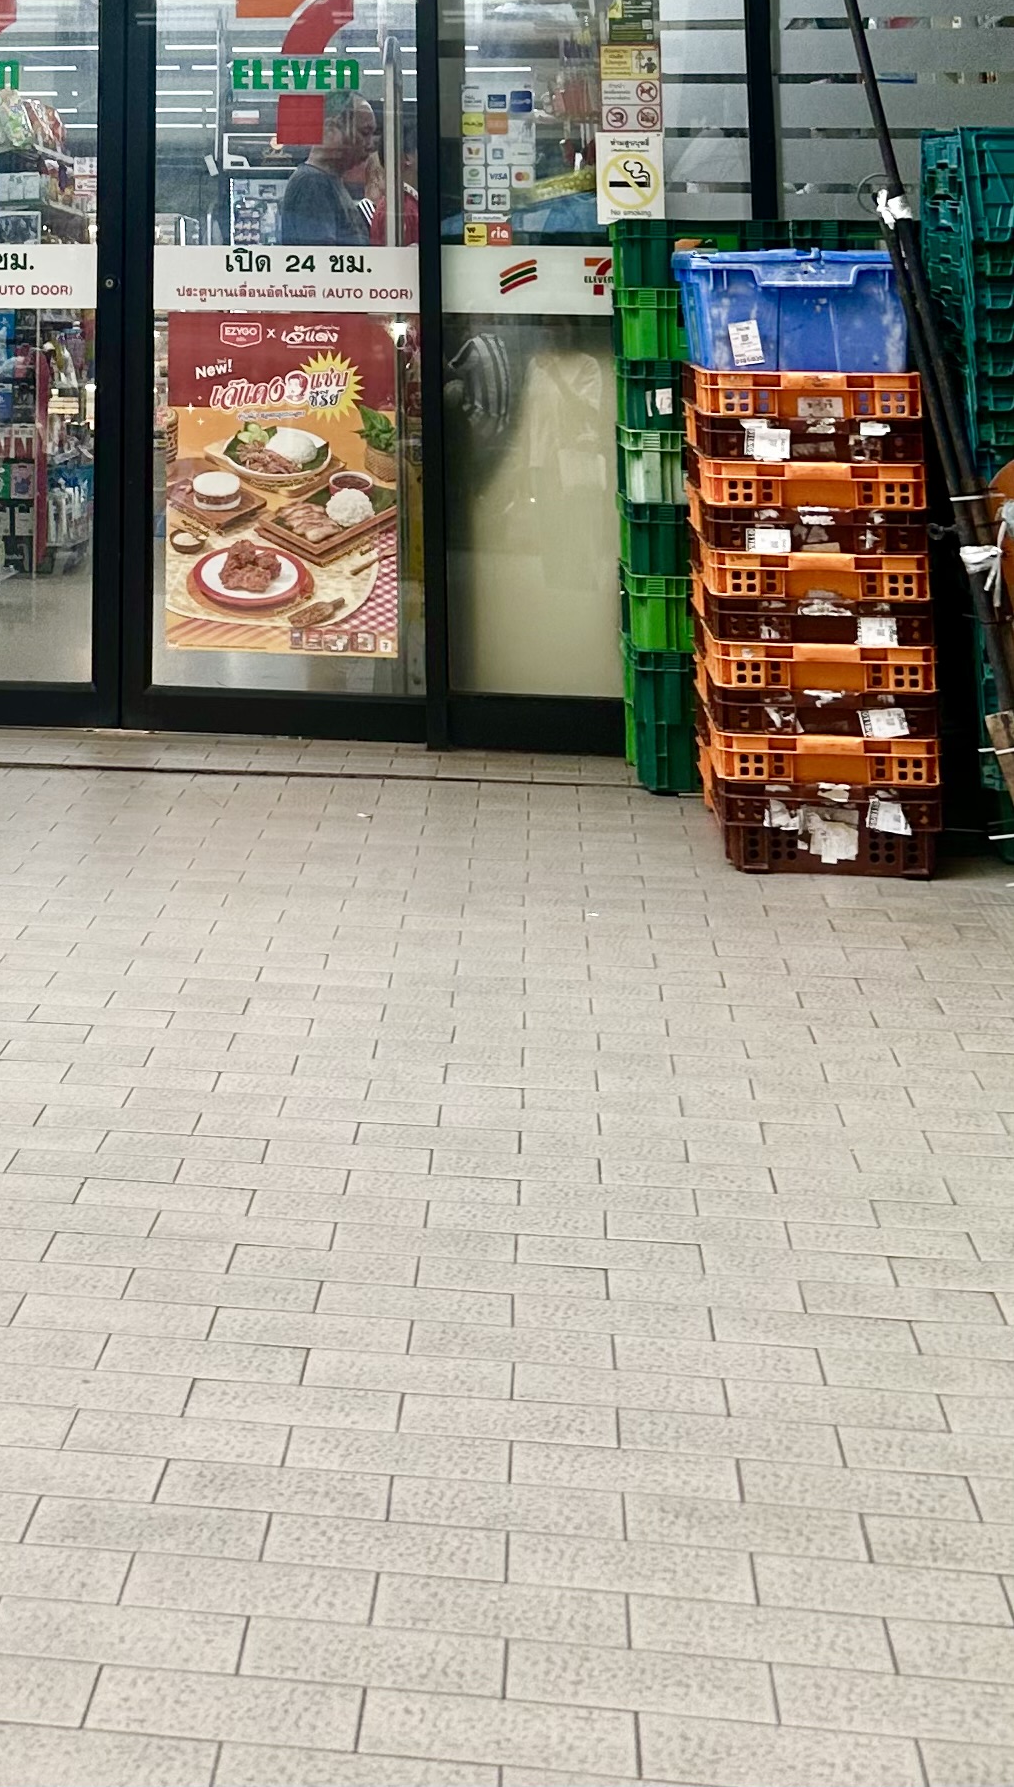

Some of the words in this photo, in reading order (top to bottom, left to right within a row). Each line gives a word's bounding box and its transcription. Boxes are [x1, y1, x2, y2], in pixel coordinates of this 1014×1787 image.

[490, 226, 509, 239] ria
[226, 248, 271, 273] เปิด
[286, 255, 315, 273] 24
[329, 254, 372, 273] ชม.
[30, 284, 73, 296] DOOR)
[322, 288, 363, 300] (AUTO
[369, 288, 413, 300] DOOR)
[225, 327, 257, 336] EZYGO
[195, 359, 233, 380] New!
[310, 367, 348, 389] แซ่บ
